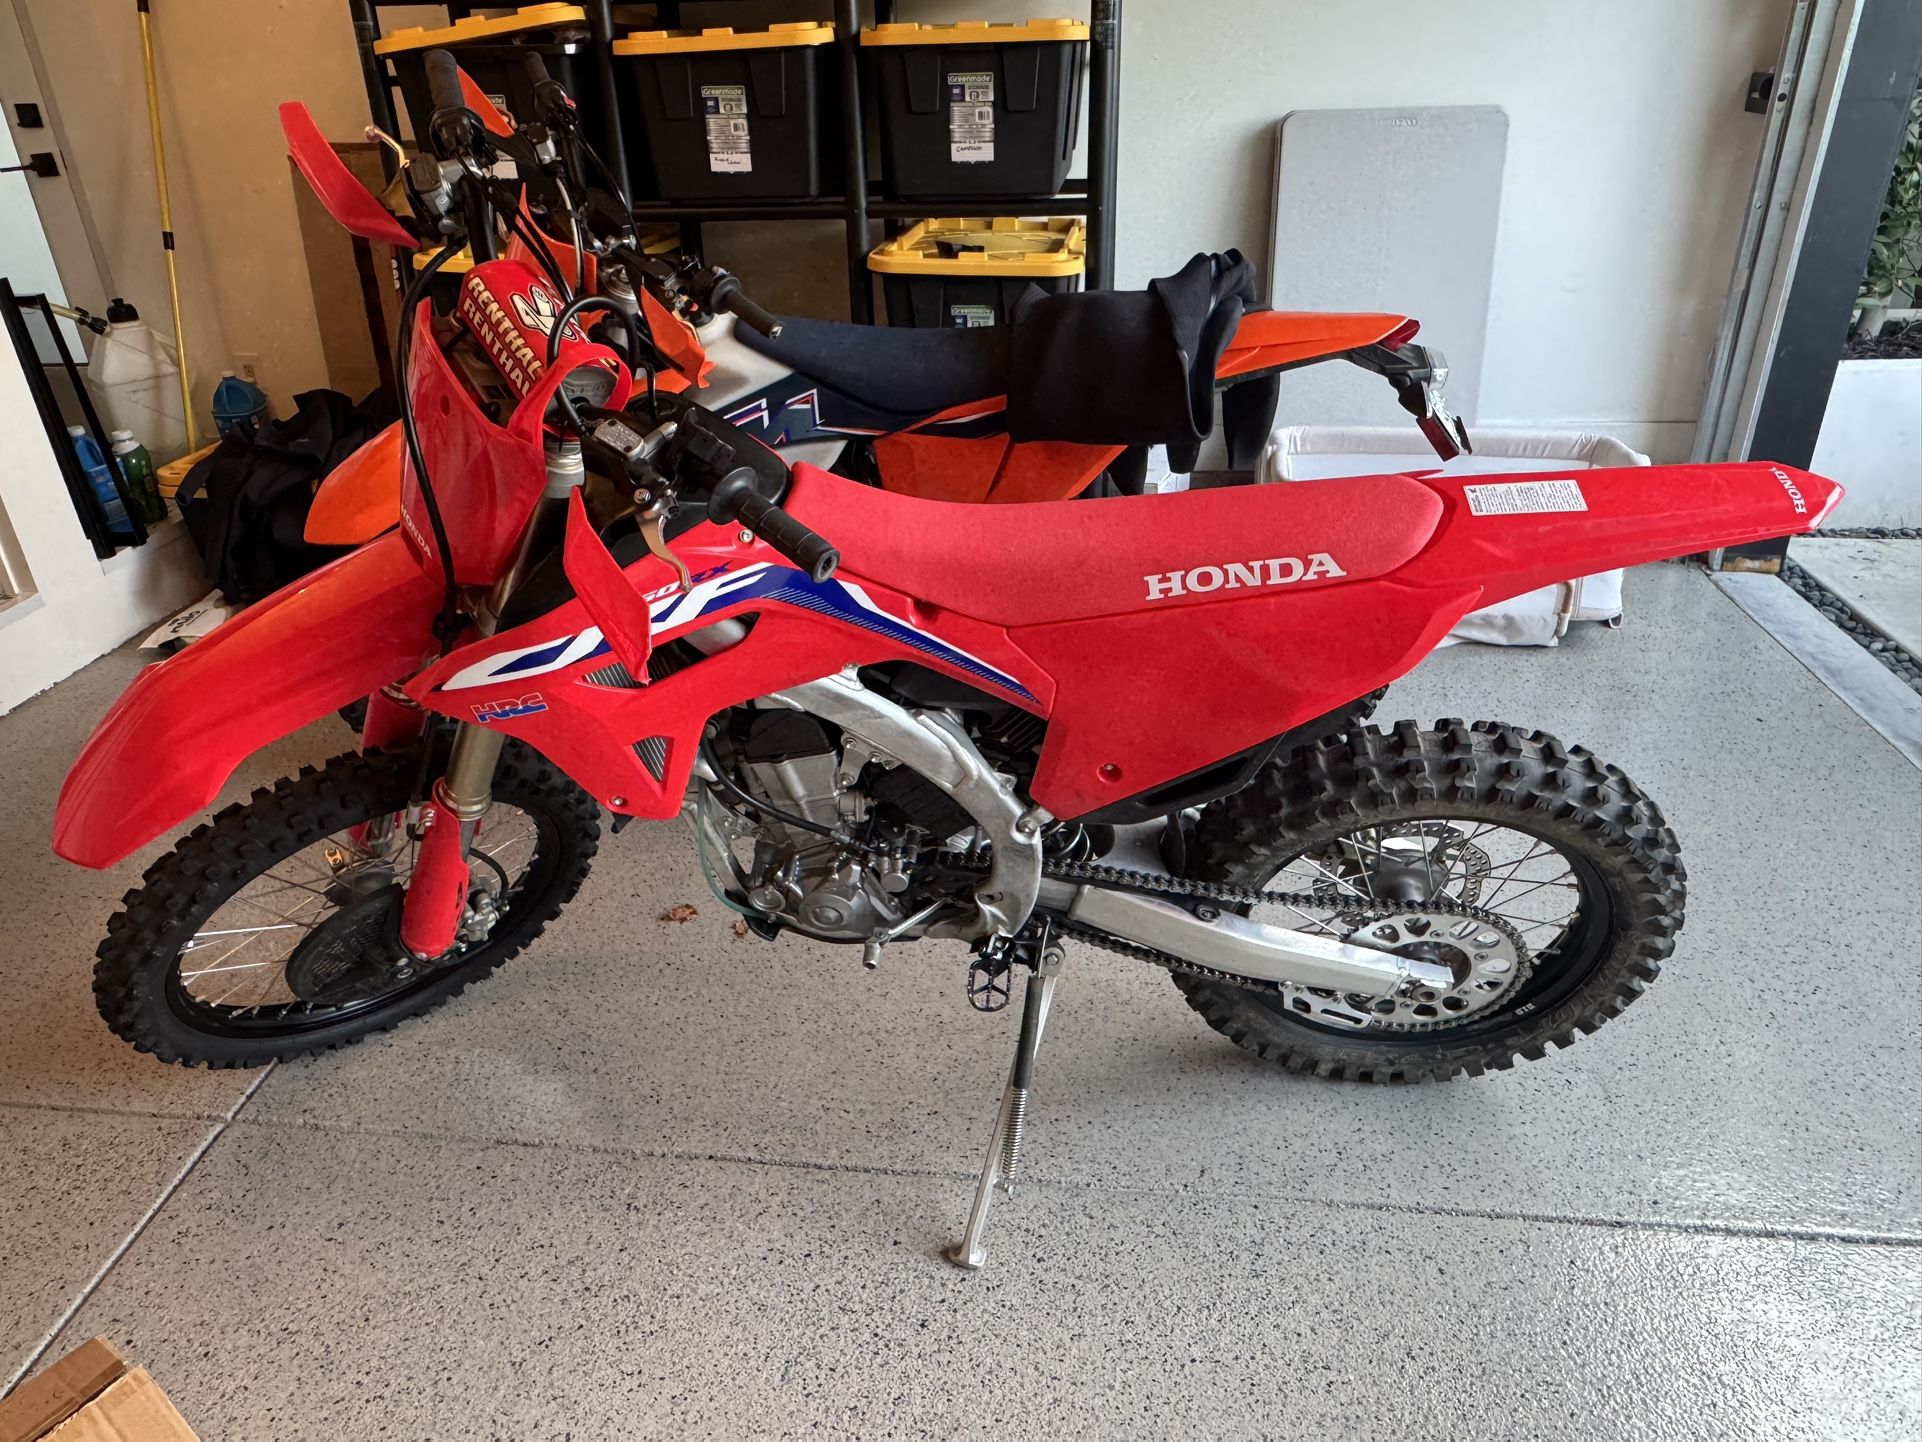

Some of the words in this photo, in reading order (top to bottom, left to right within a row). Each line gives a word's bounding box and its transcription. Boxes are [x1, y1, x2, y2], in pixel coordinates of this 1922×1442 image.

[703, 88, 743, 96] Greenmade
[467, 276, 543, 381] RENTHAL
[1144, 552, 1347, 600] HONDA
[470, 692, 548, 723] HRC
